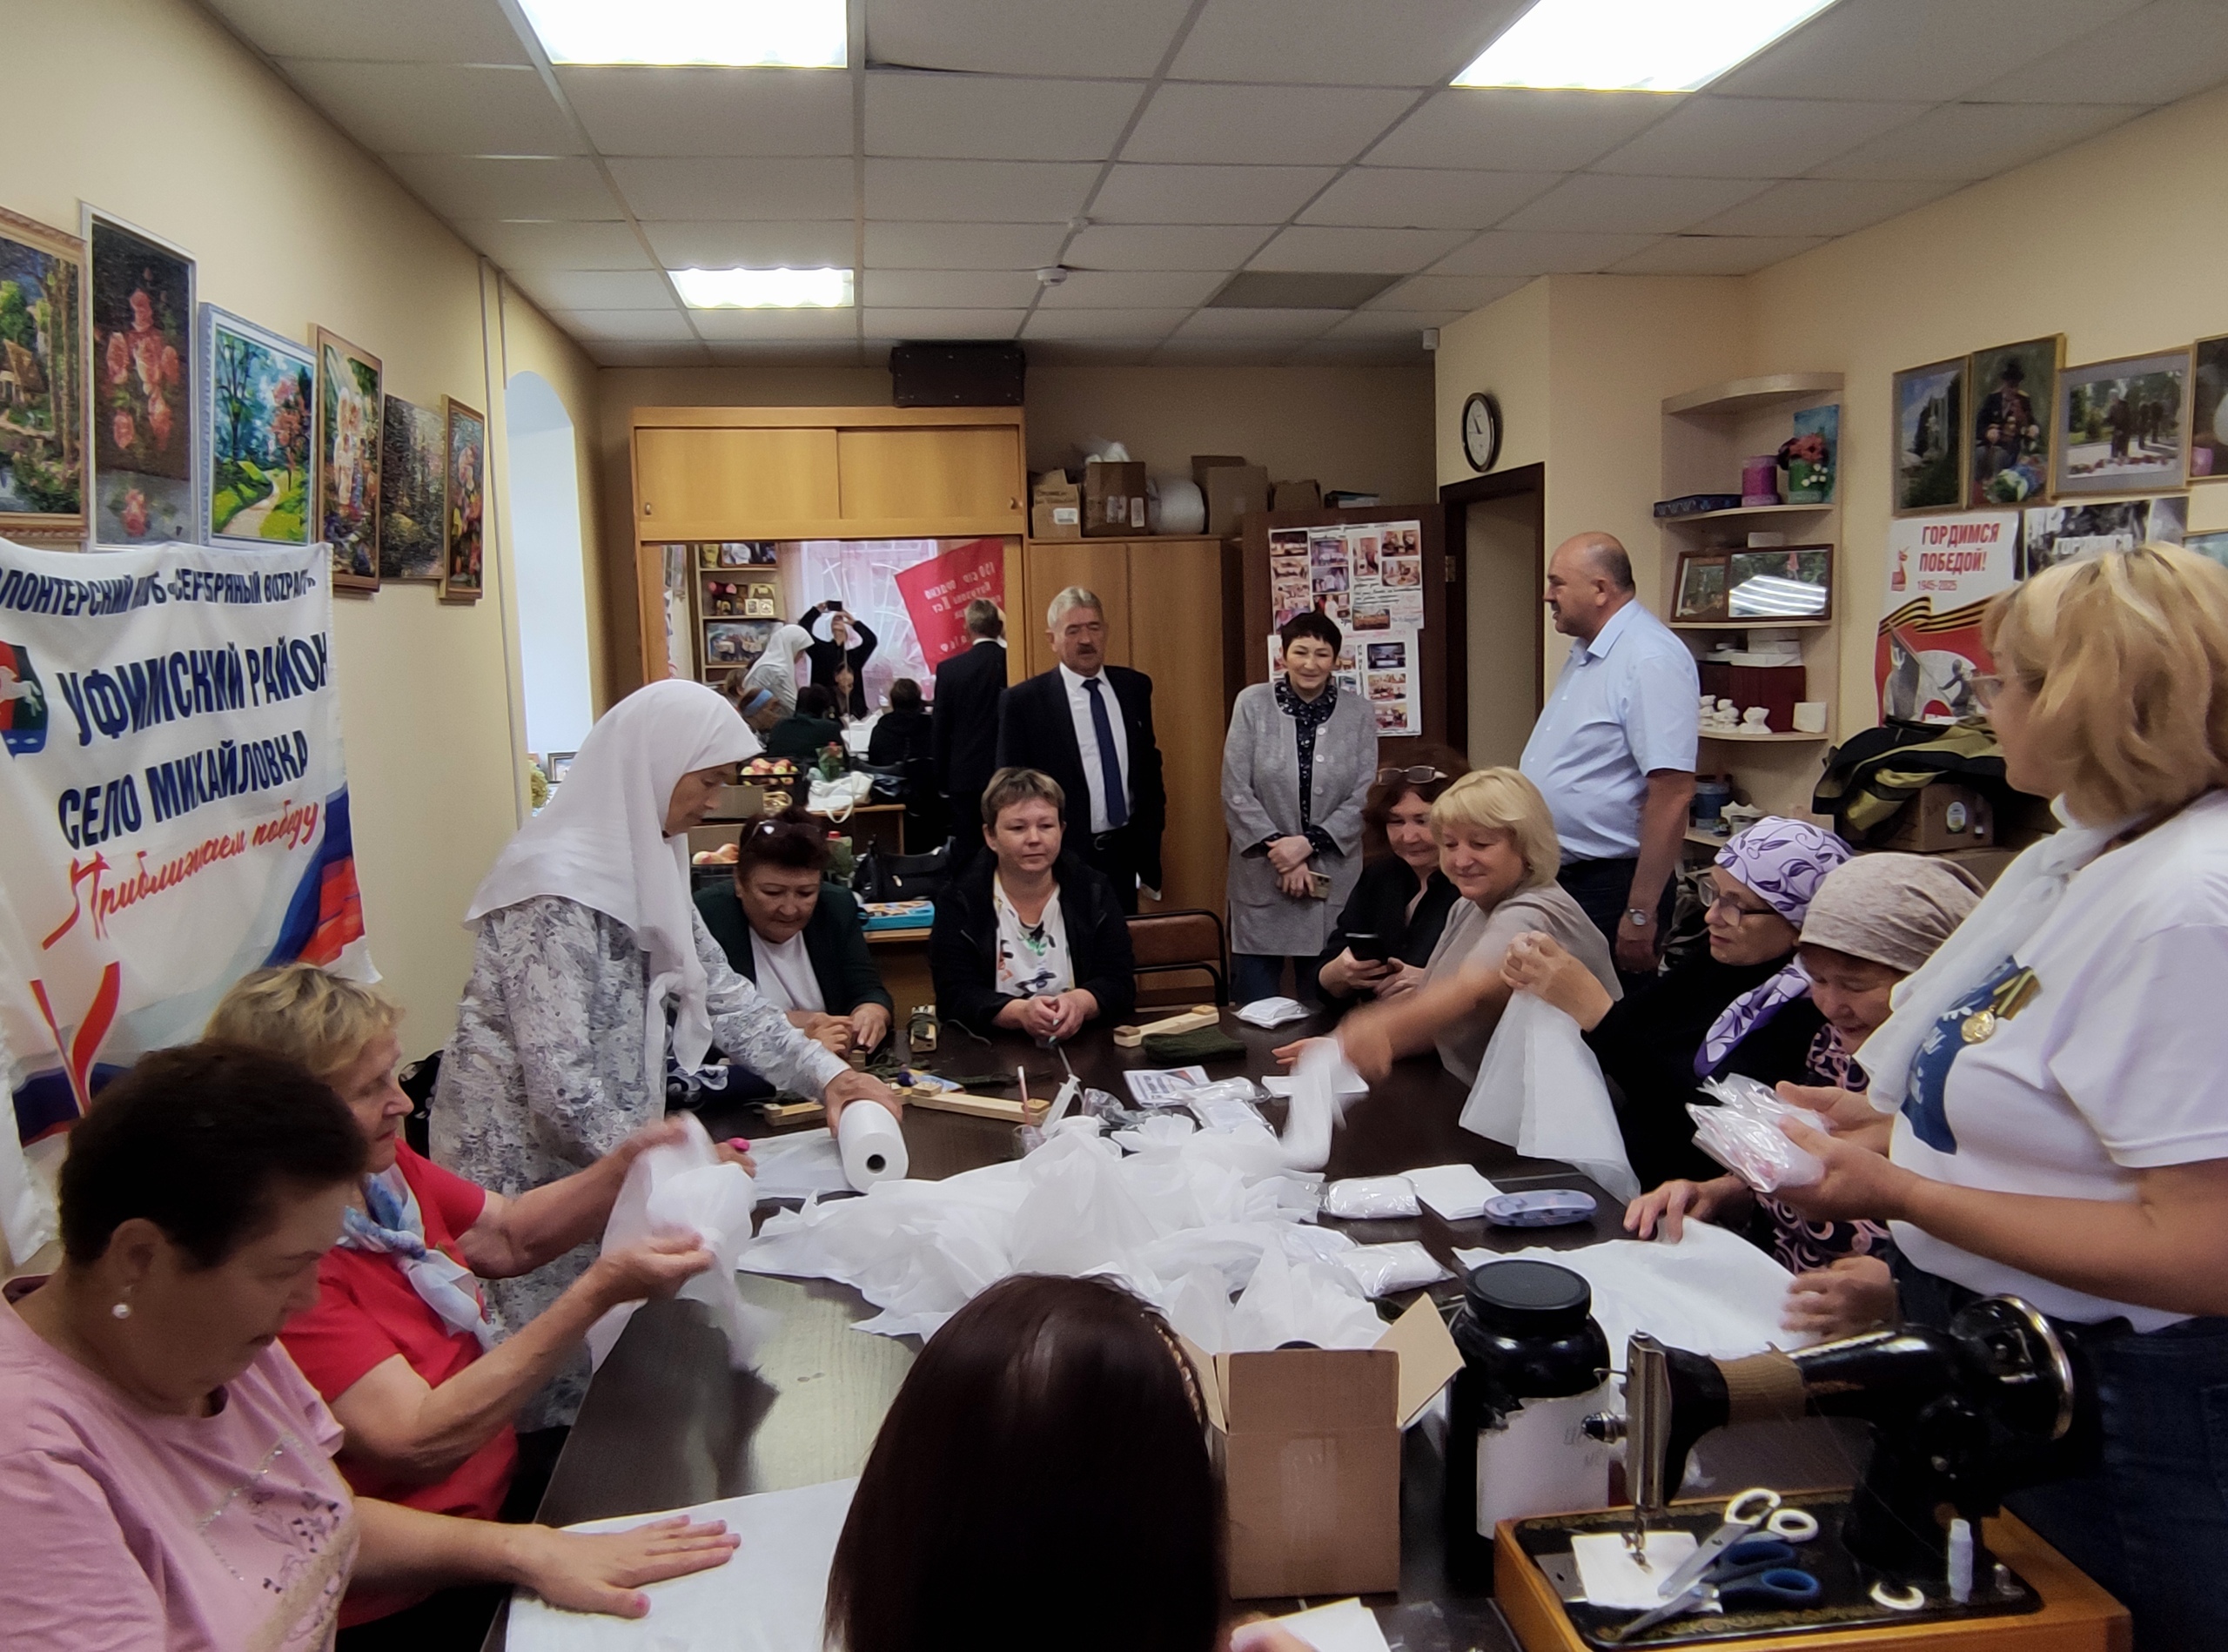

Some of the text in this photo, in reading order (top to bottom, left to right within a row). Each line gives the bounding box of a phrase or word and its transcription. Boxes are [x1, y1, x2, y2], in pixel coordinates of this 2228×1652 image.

[1922, 523, 2000, 547] ГОРДИМСЯ
[1919, 547, 1987, 575] ПОБЕДОЙ!
[0, 567, 133, 616] ЛОНТЕРСКИЙ
[56, 631, 326, 747] УФИМСКИЙ РАЙОН
[58, 729, 308, 850] СЕЛО МИХАЙЛОВКА
